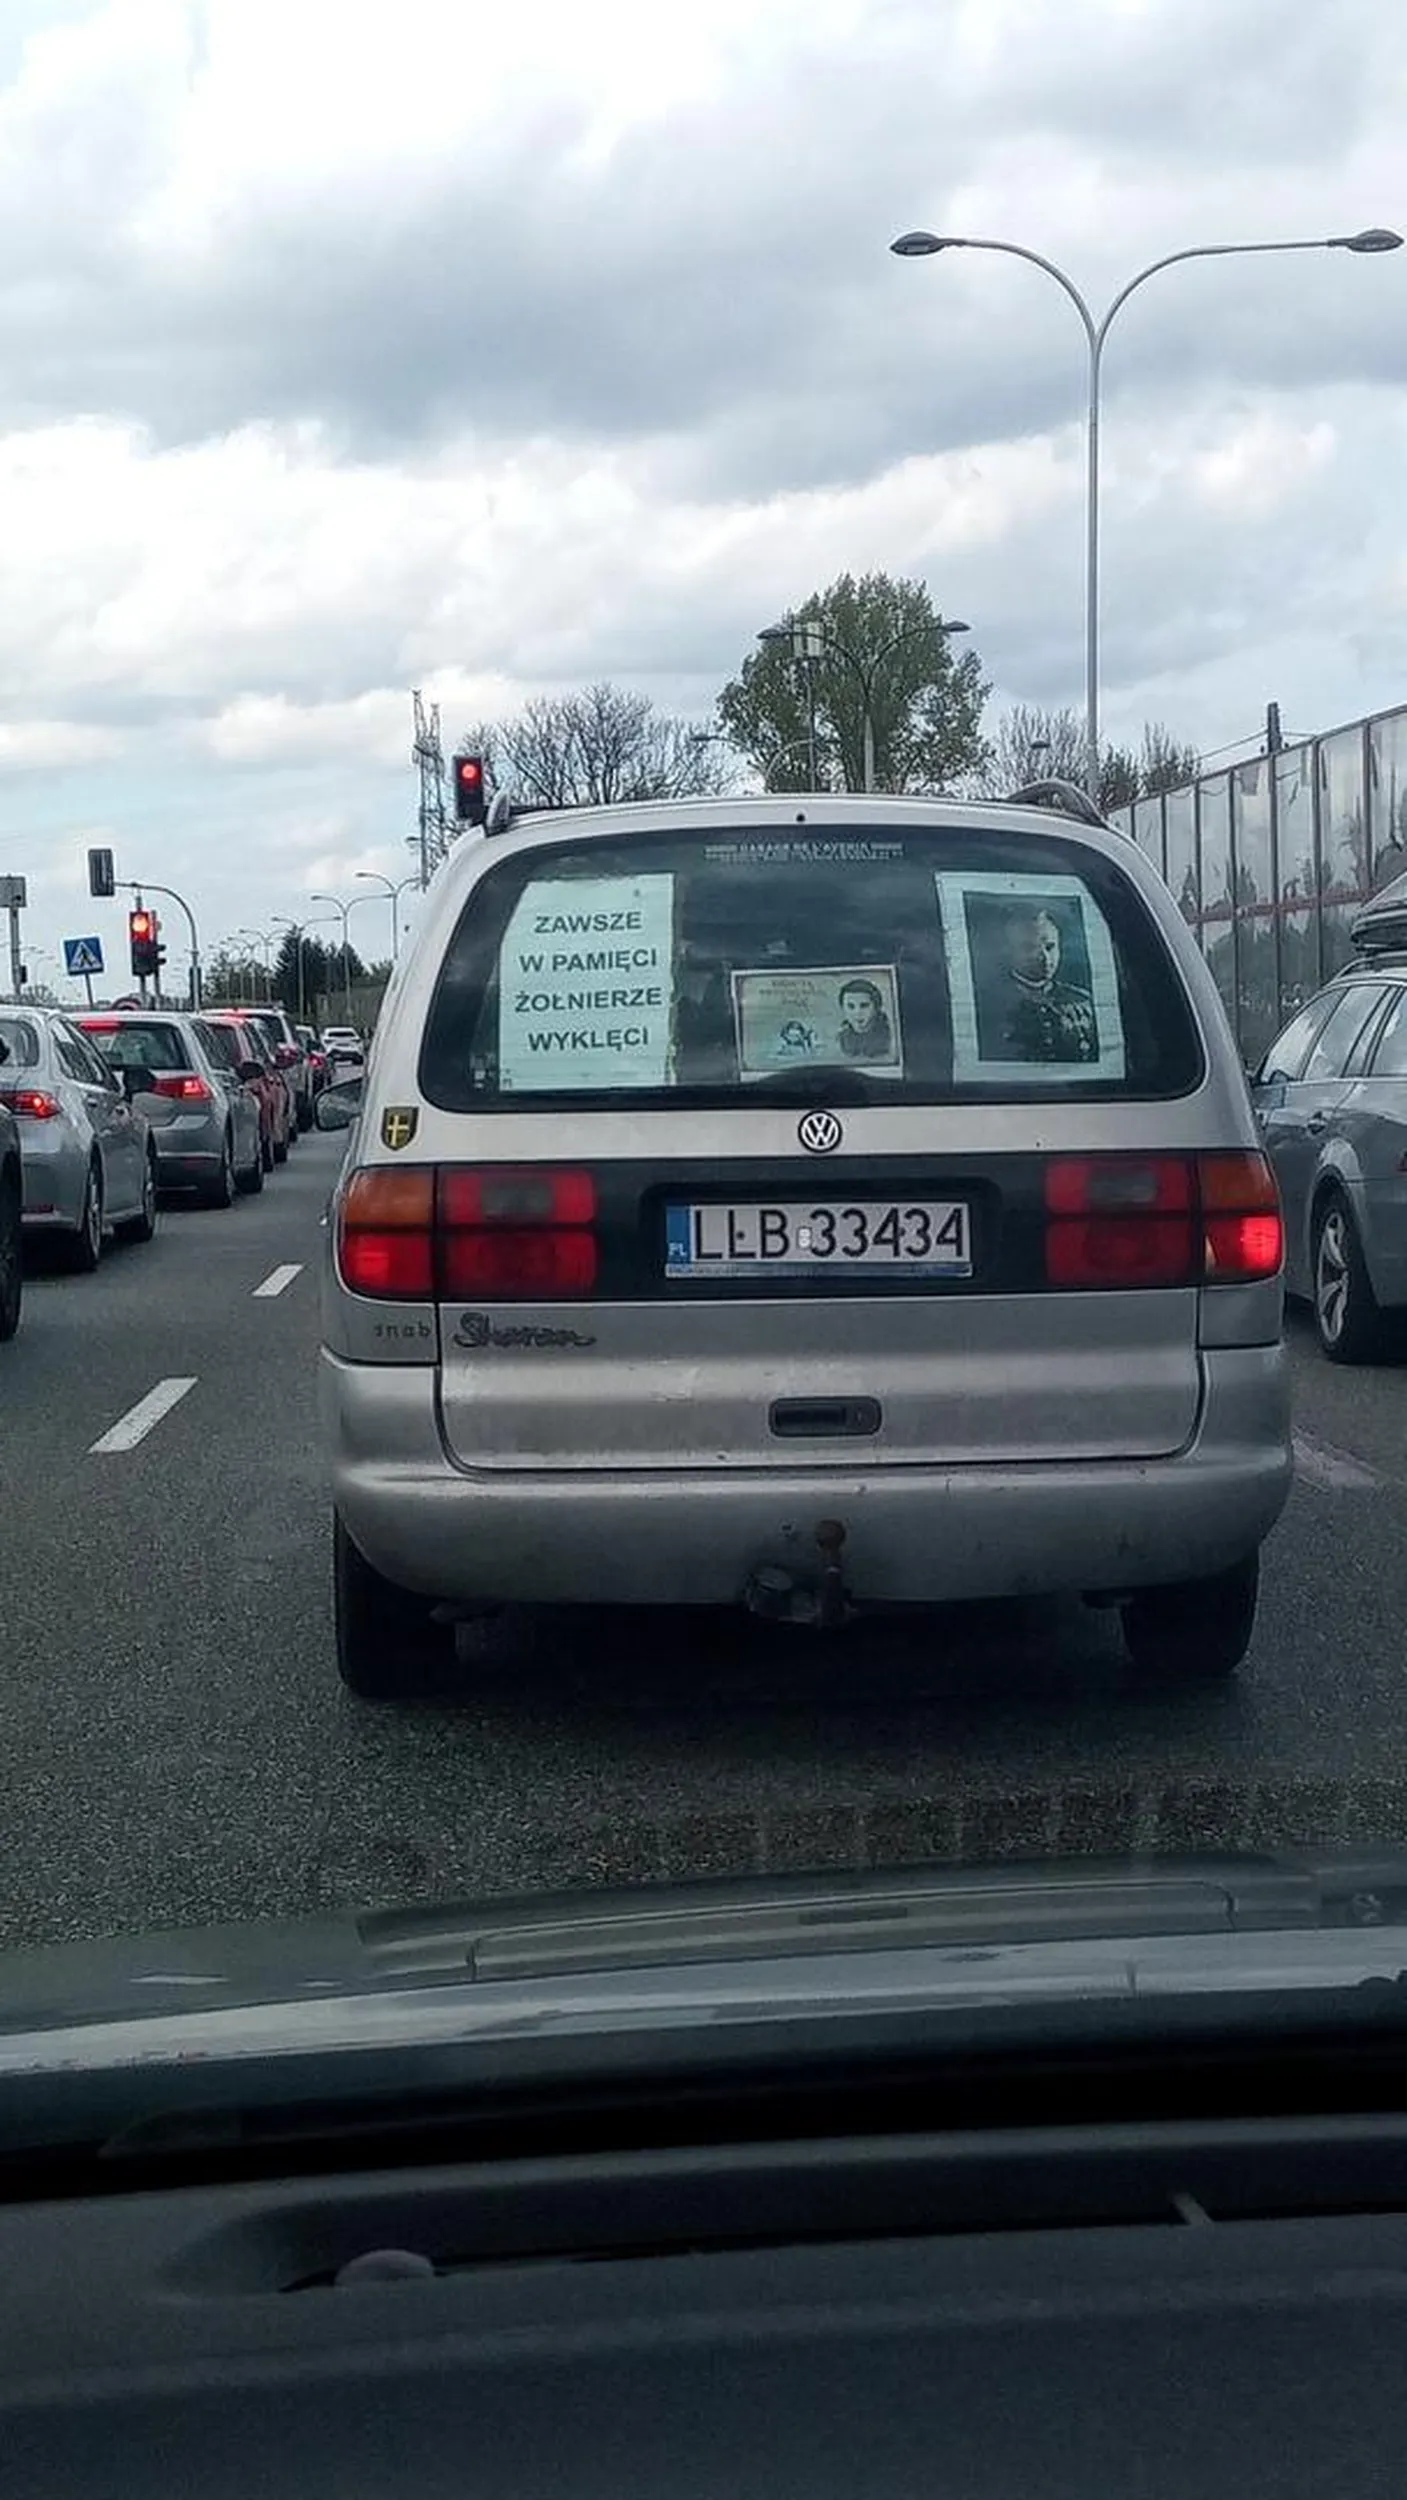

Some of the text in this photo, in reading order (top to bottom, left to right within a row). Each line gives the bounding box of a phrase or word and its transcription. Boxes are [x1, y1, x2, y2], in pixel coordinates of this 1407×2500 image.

[534, 911, 642, 934] ZAWSZE
[519, 948, 657, 973] W PAMIĘCI
[515, 986, 663, 1013] ŻOŁNIERZE
[528, 1026, 649, 1052] WYKLĘCI
[695, 1208, 789, 1259] LLB
[809, 1207, 964, 1258] 33434
